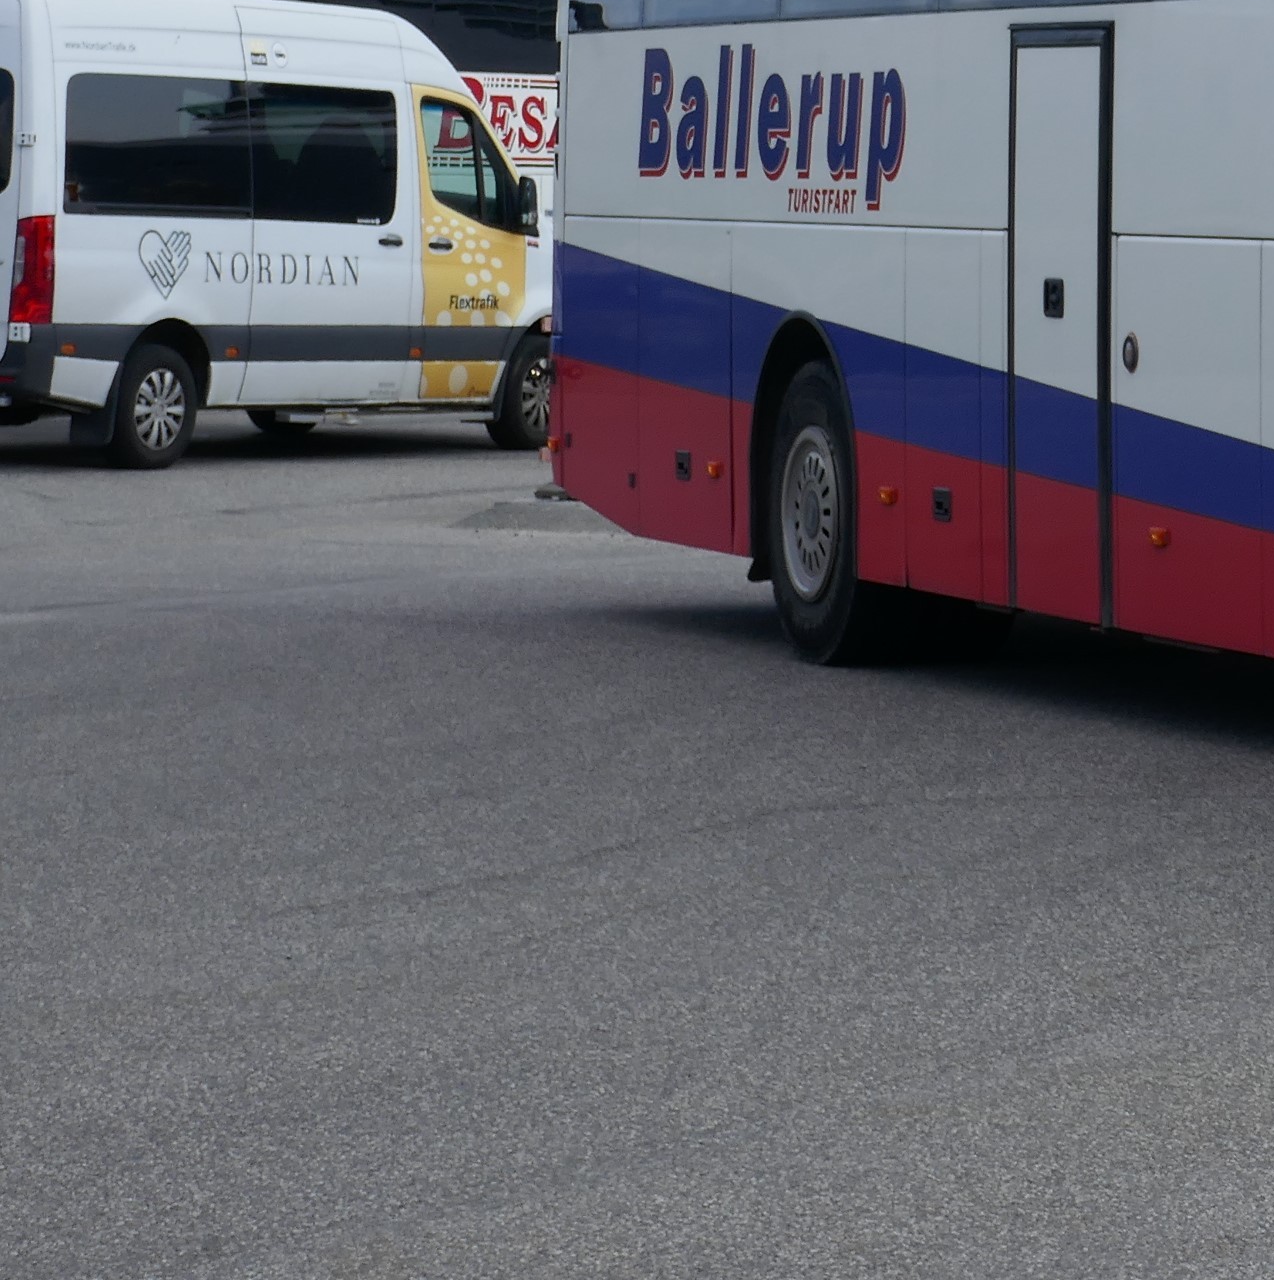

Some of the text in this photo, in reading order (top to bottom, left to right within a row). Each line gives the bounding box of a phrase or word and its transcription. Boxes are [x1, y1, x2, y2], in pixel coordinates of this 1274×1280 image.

[433, 76, 559, 153] BES
[638, 43, 906, 211] Ballerup
[787, 188, 857, 214] TURISTFART
[204, 251, 359, 286] NORDIAN
[449, 294, 500, 310] Flextrafik
